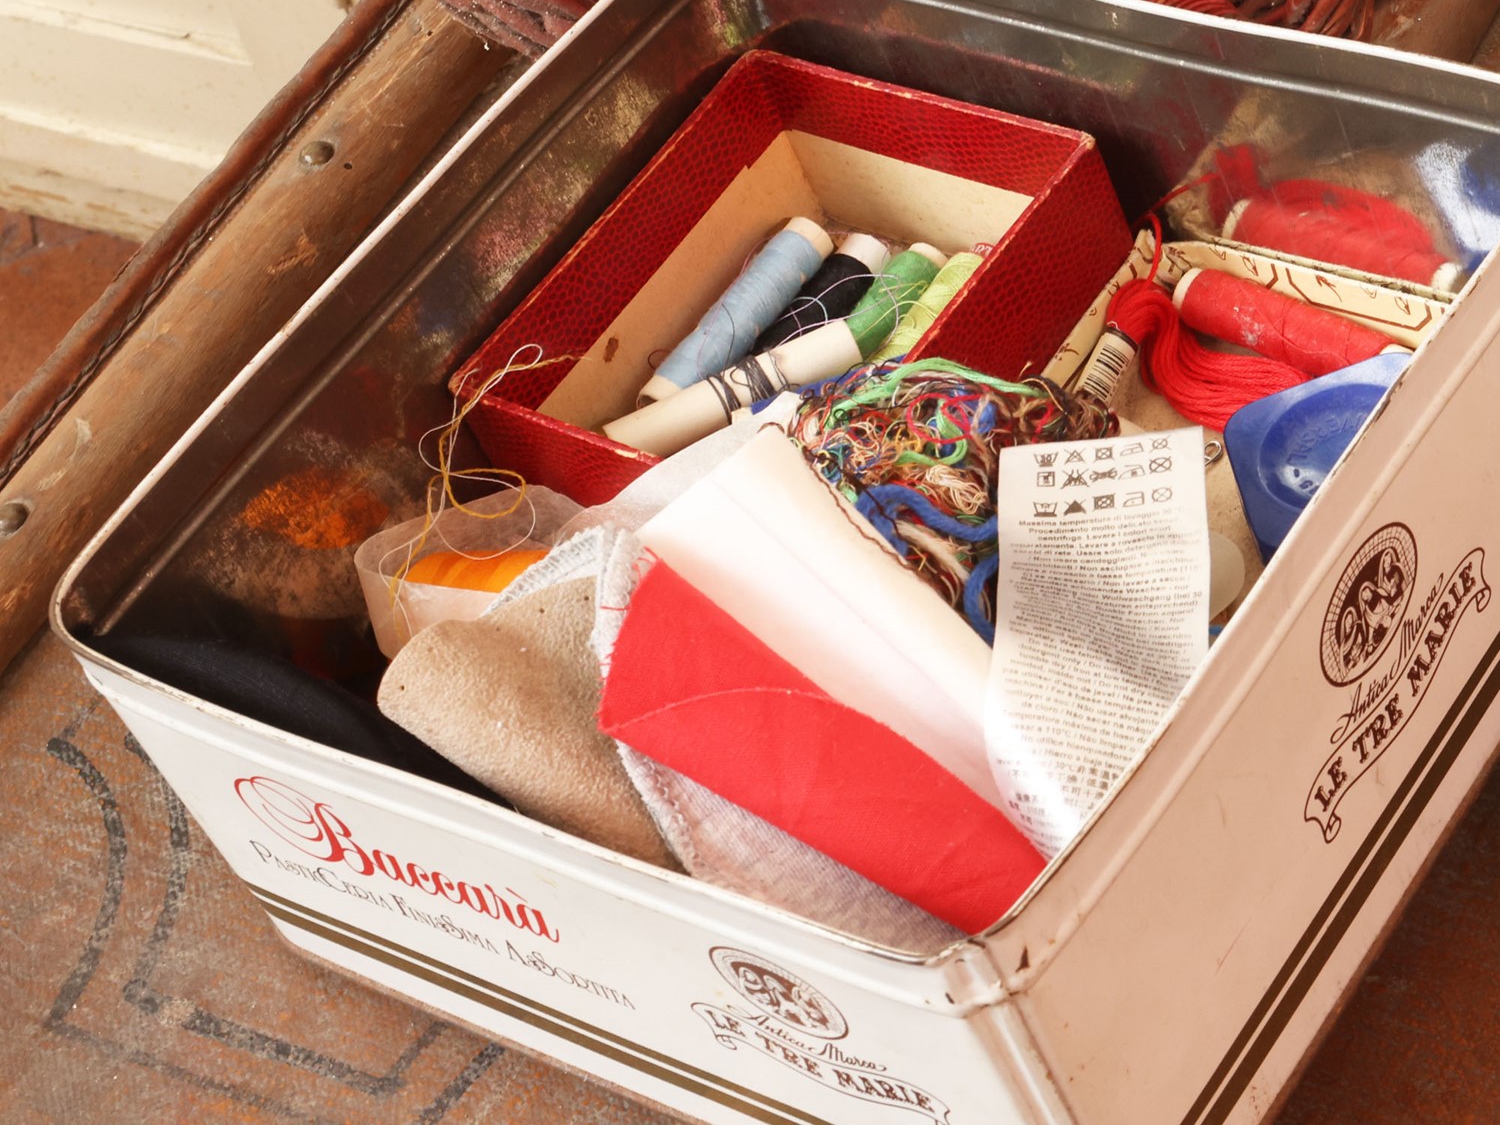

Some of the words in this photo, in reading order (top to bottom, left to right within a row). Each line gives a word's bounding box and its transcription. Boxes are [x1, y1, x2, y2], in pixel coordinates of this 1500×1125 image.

[1314, 756, 1348, 812] LE
[1352, 693, 1404, 764] TRE
[1406, 562, 1477, 697] MARIE
[1330, 676, 1391, 745] Antica
[1389, 572, 1445, 682] Marca
[233, 776, 560, 943] Baccarà
[704, 1009, 746, 1038] LE
[755, 1031, 823, 1078] TRE
[832, 1068, 935, 1113] MARIE
